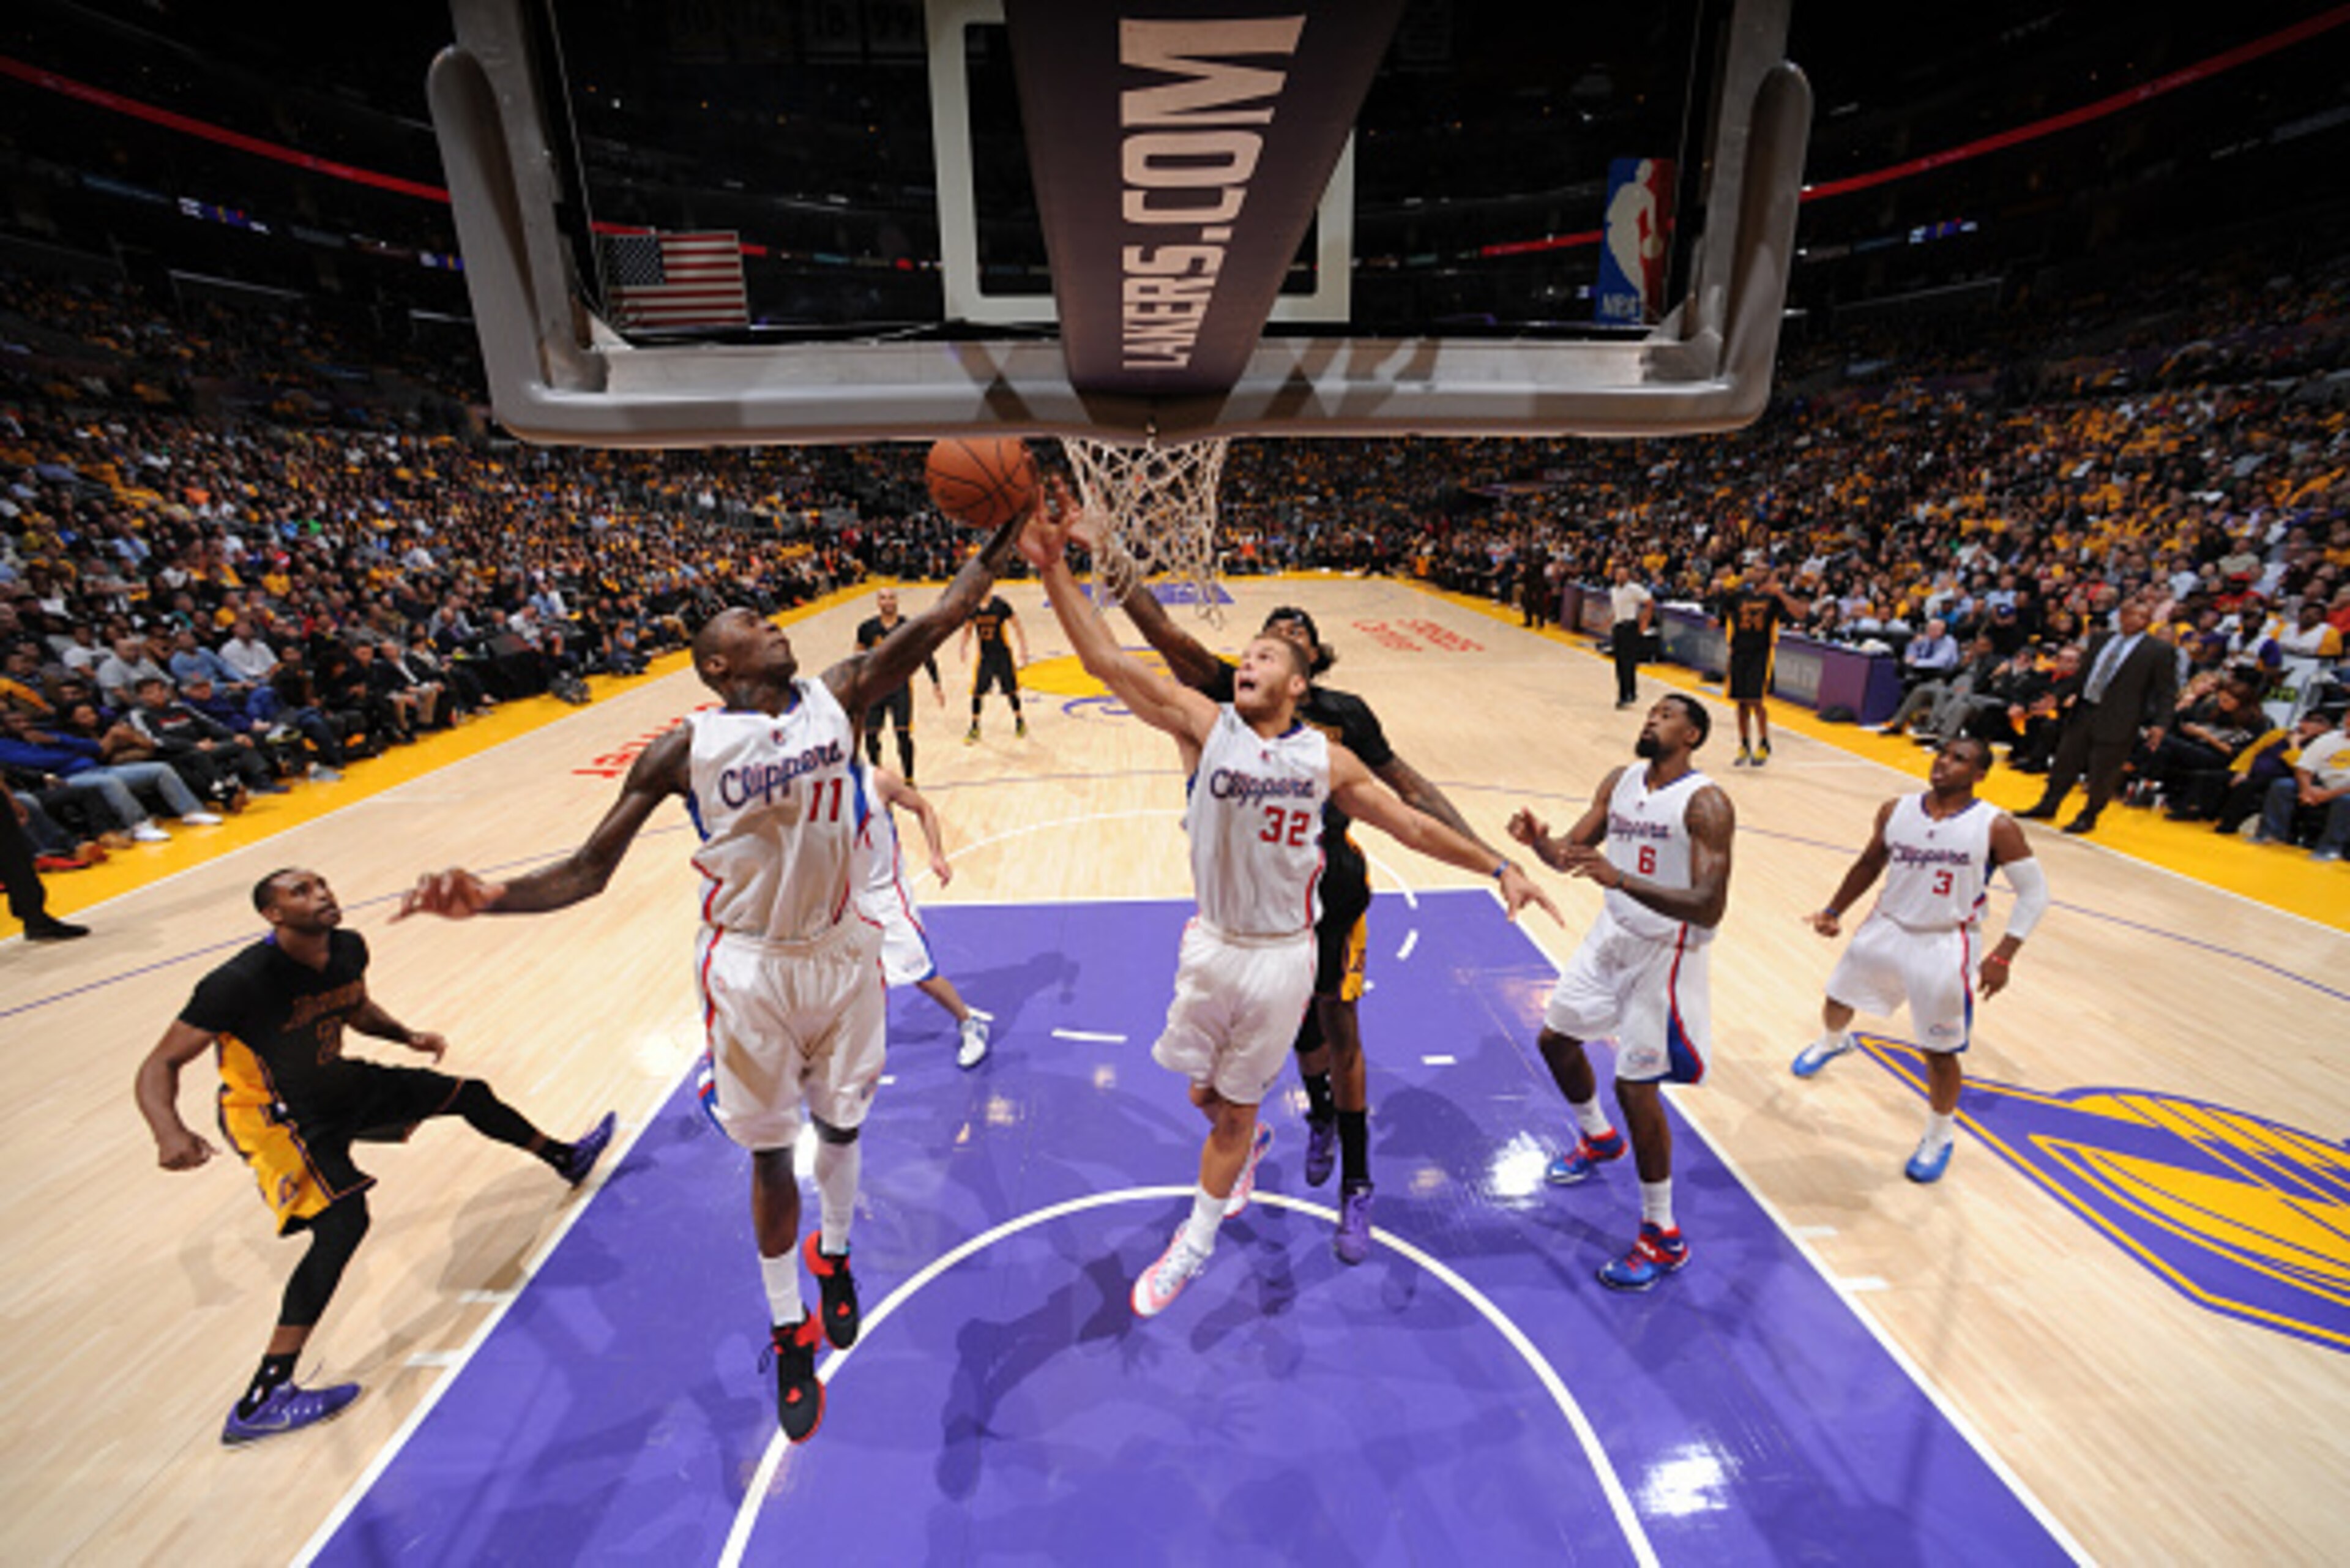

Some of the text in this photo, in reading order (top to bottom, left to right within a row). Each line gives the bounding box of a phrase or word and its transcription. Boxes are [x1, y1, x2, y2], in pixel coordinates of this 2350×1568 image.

[1119, 15, 1307, 369] LAKERS.COM
[718, 738, 845, 810] Clippers
[1210, 767, 1315, 808] Clippers
[808, 777, 843, 823] 11
[1259, 805, 1310, 848] 32
[1638, 845, 1656, 875] 6
[1932, 869, 1954, 897] 3
